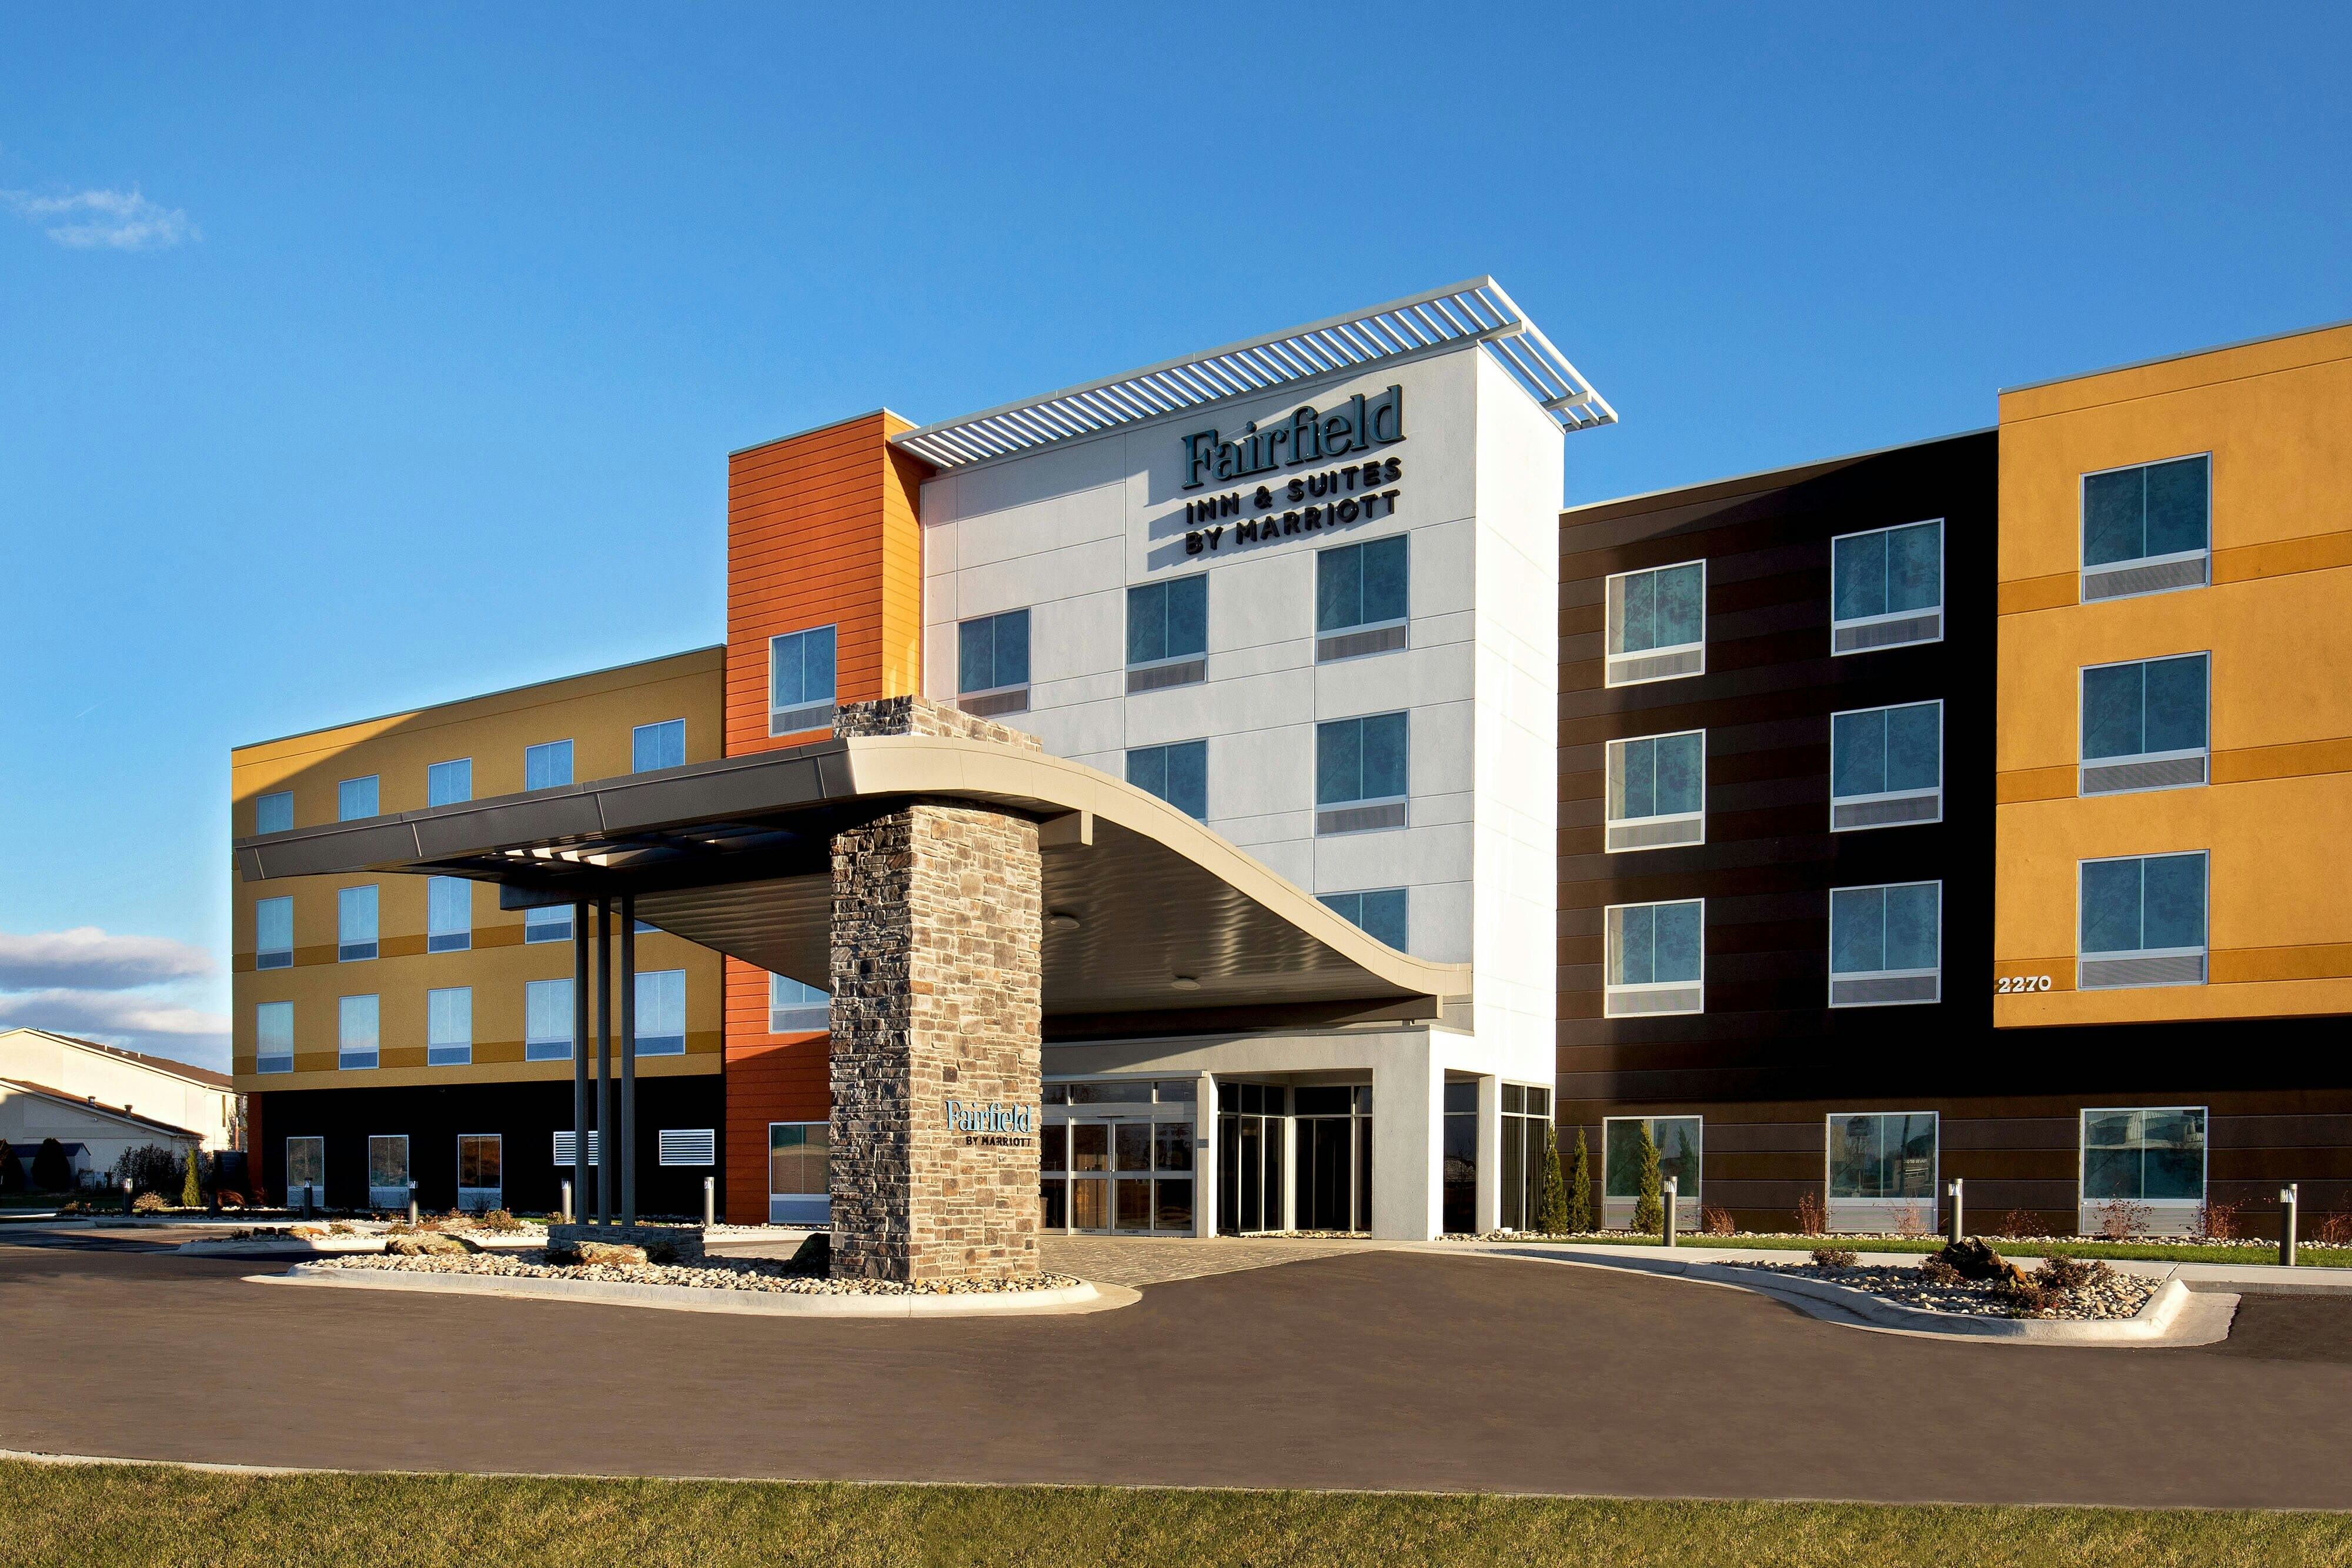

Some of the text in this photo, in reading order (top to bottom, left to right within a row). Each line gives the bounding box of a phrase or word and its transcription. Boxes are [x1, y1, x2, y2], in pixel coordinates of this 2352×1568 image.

[1181, 384, 1406, 489] Fairfield
[1186, 457, 1402, 524] INN & SUITES
[1185, 489, 1400, 555] BY MARRIOTT
[1998, 975, 2052, 992] 2270
[946, 1101, 1031, 1134] Fairfield
[965, 1136, 1031, 1146] BY MARRIOTT
